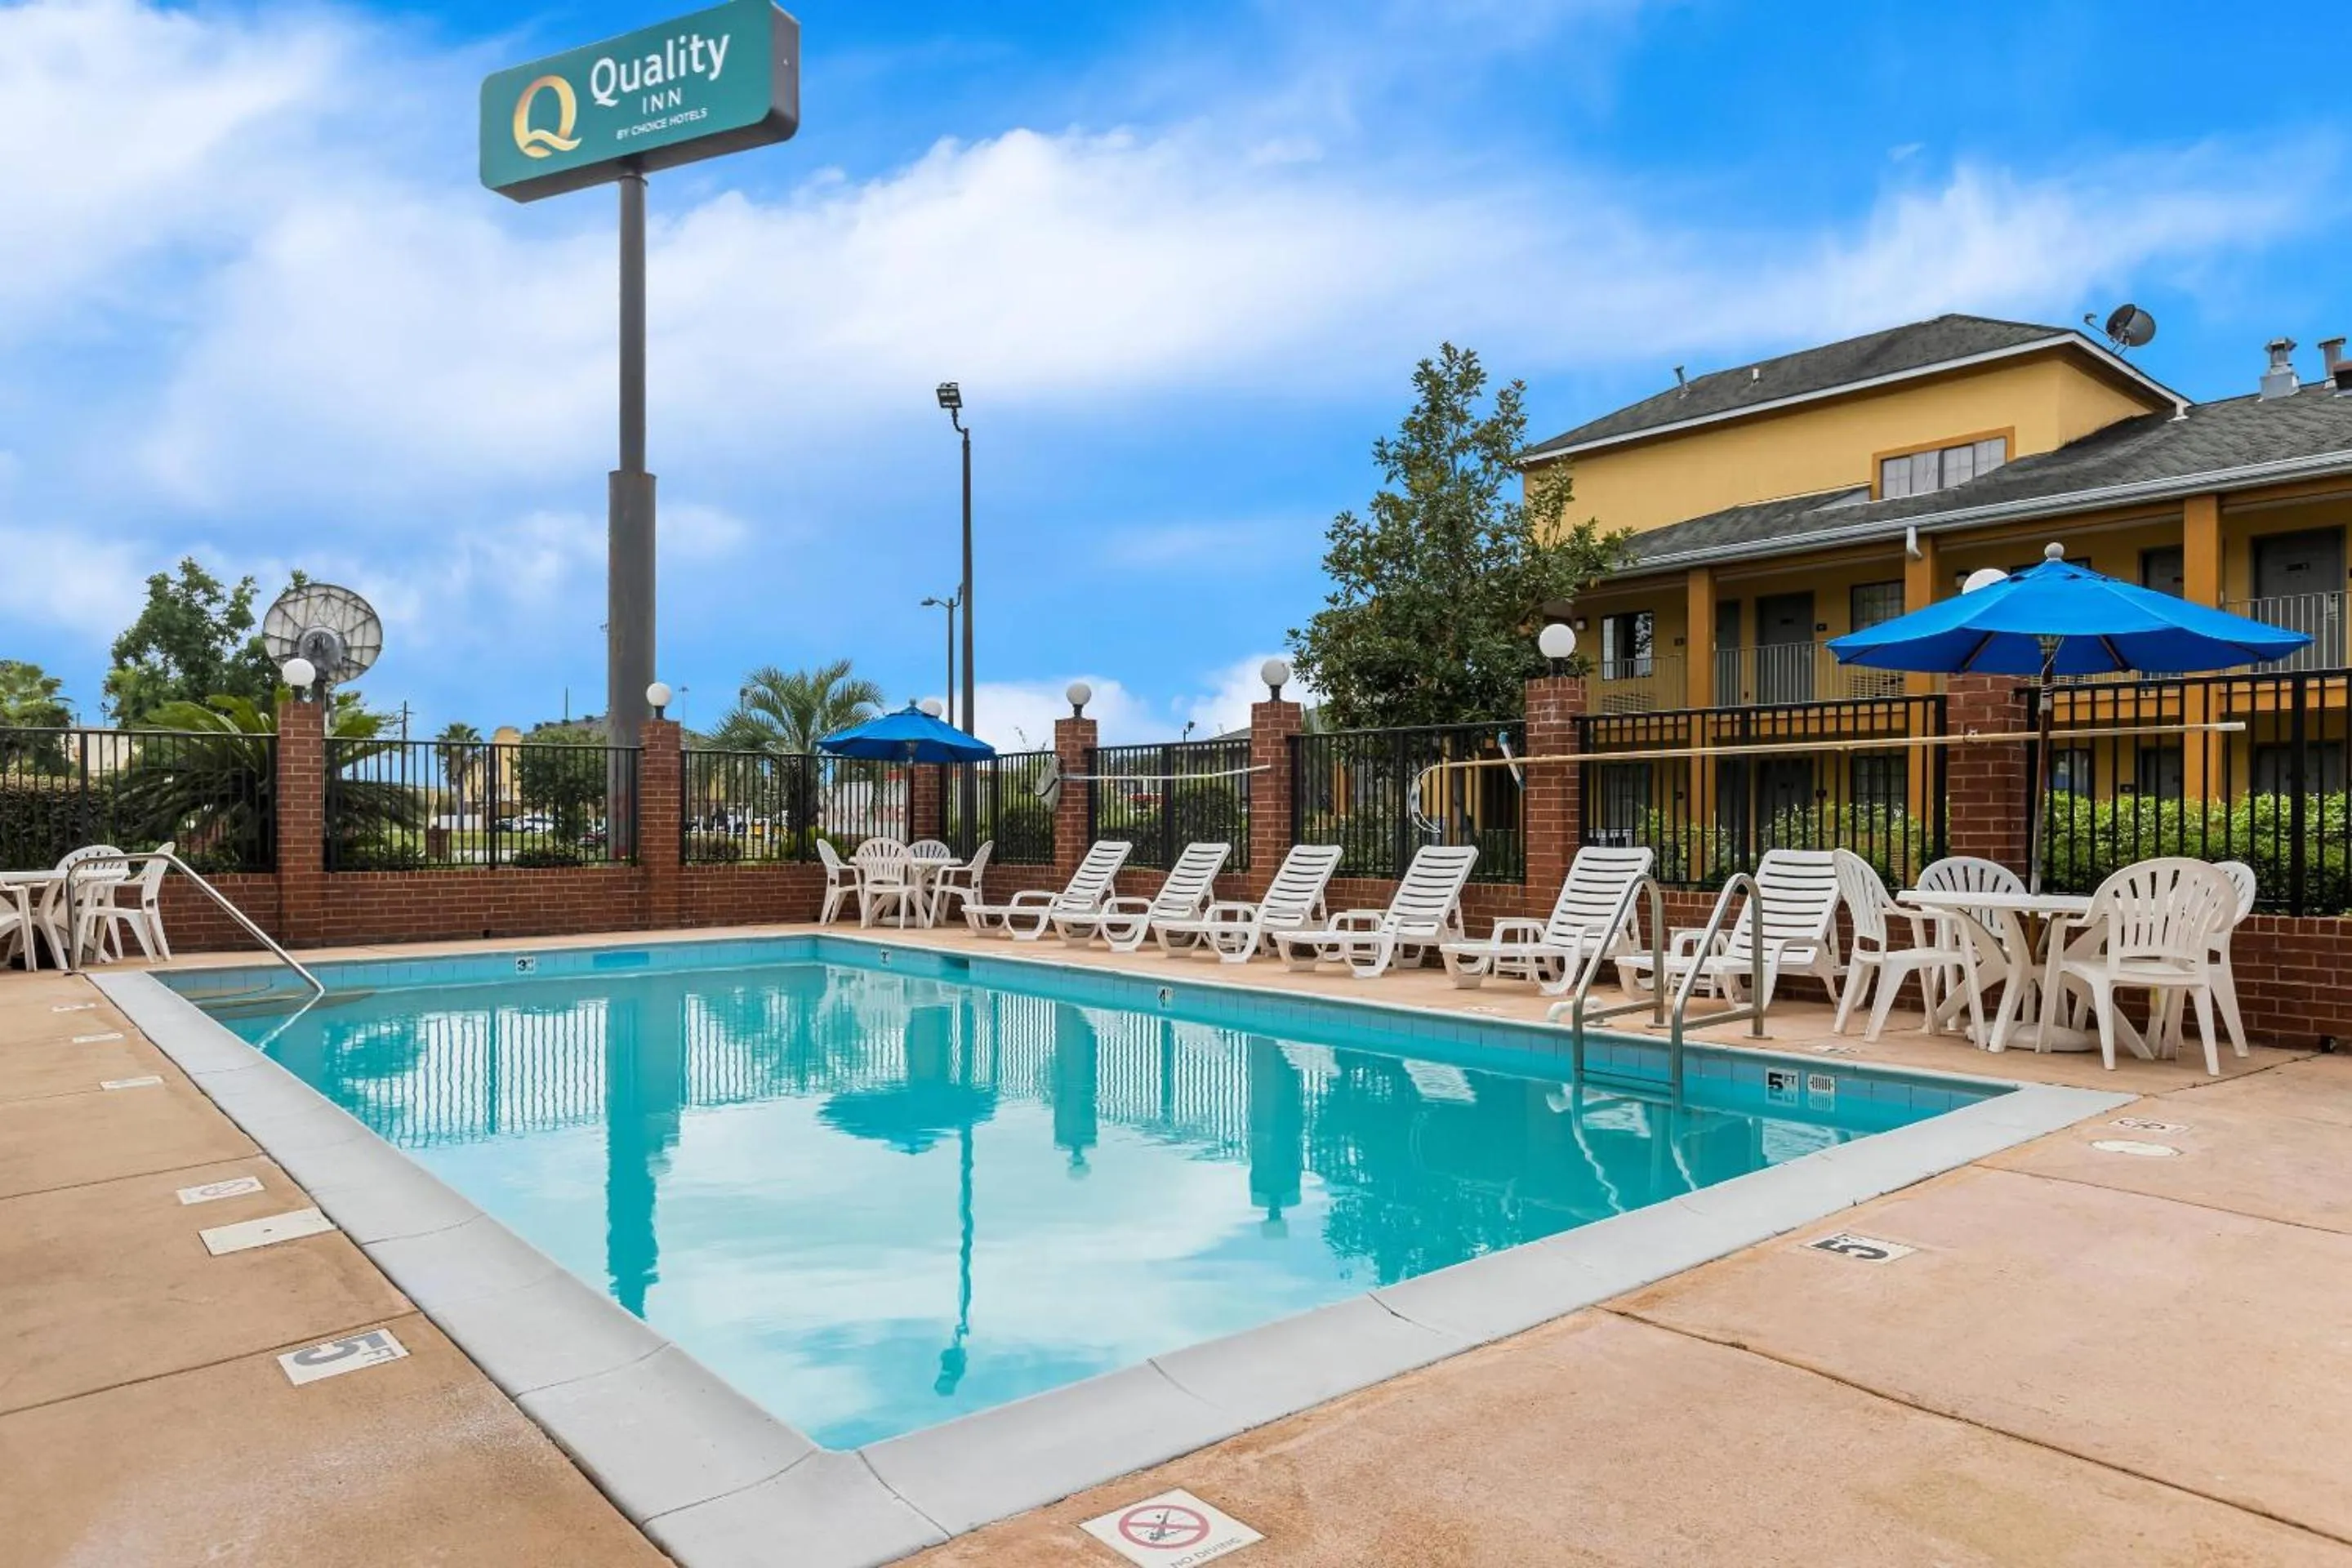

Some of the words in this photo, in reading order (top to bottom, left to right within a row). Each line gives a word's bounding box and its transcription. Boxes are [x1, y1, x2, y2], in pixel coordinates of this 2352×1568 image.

[590, 33, 730, 107] Quality
[514, 74, 581, 158] Q
[642, 87, 681, 115] INN
[617, 128, 629, 140] BY
[631, 118, 667, 136] CHOICE
[669, 108, 708, 126] HOTELS
[1768, 1072, 1784, 1093] 5
[1784, 1075, 1797, 1085] FT
[1811, 1239, 1889, 1259] 5
[294, 1333, 387, 1365] 5
[1169, 1557, 1192, 1568] NO
[1194, 1537, 1242, 1557] DIVING
